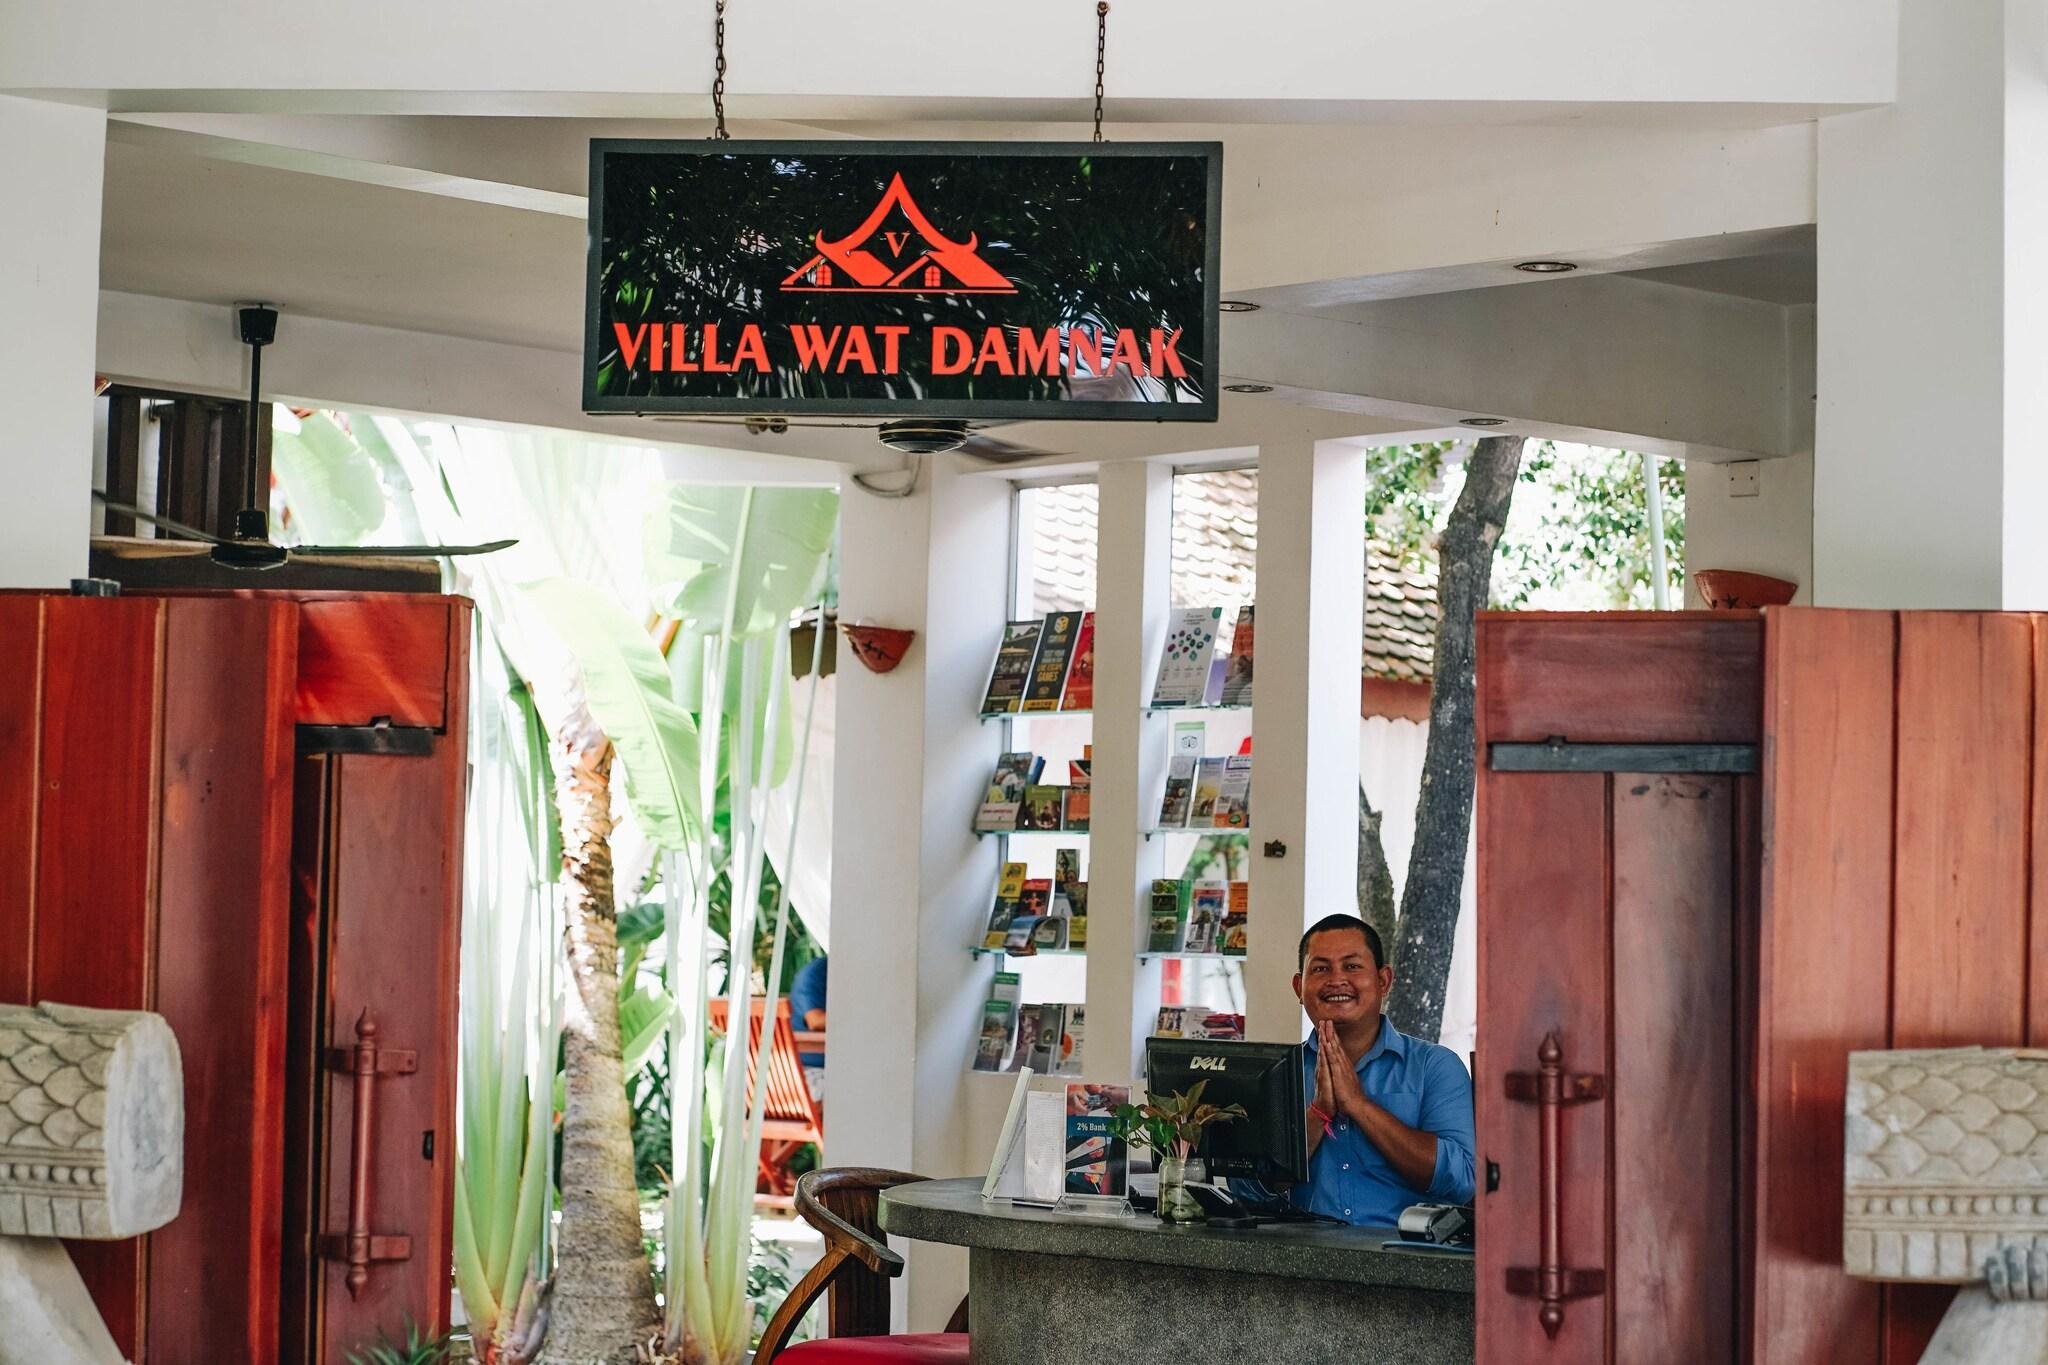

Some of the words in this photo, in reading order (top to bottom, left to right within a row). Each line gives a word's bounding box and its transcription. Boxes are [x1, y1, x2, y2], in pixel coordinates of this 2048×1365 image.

[884, 231, 908, 258] V
[613, 322, 772, 373] VILLA
[790, 325, 911, 374] WAT
[931, 326, 1188, 378] DAMNAK
[1190, 1056, 1226, 1070] DELL
[1077, 1122, 1088, 1131] 2%
